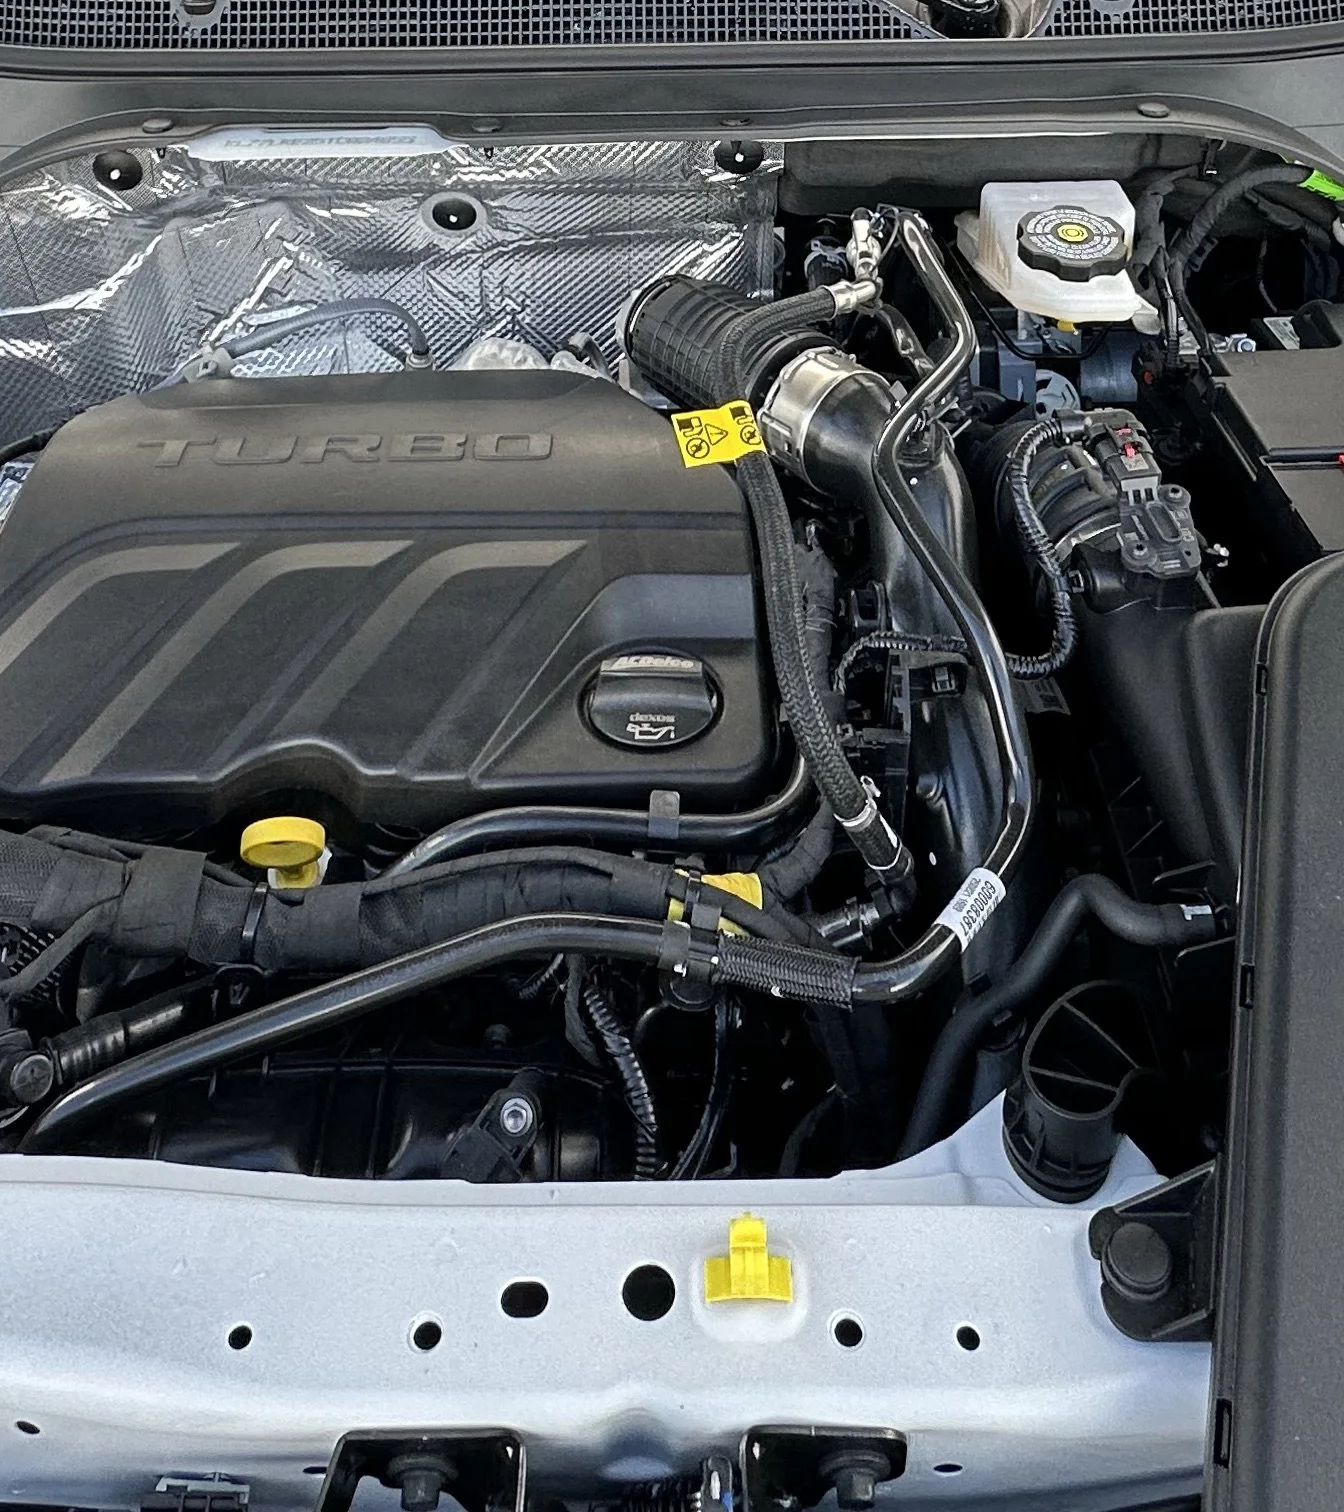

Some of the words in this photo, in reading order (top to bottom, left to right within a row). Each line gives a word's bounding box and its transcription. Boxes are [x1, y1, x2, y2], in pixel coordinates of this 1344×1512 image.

[137, 432, 554, 468] TURBO
[612, 655, 694, 669] ACDelco
[629, 713, 676, 723] dexos
